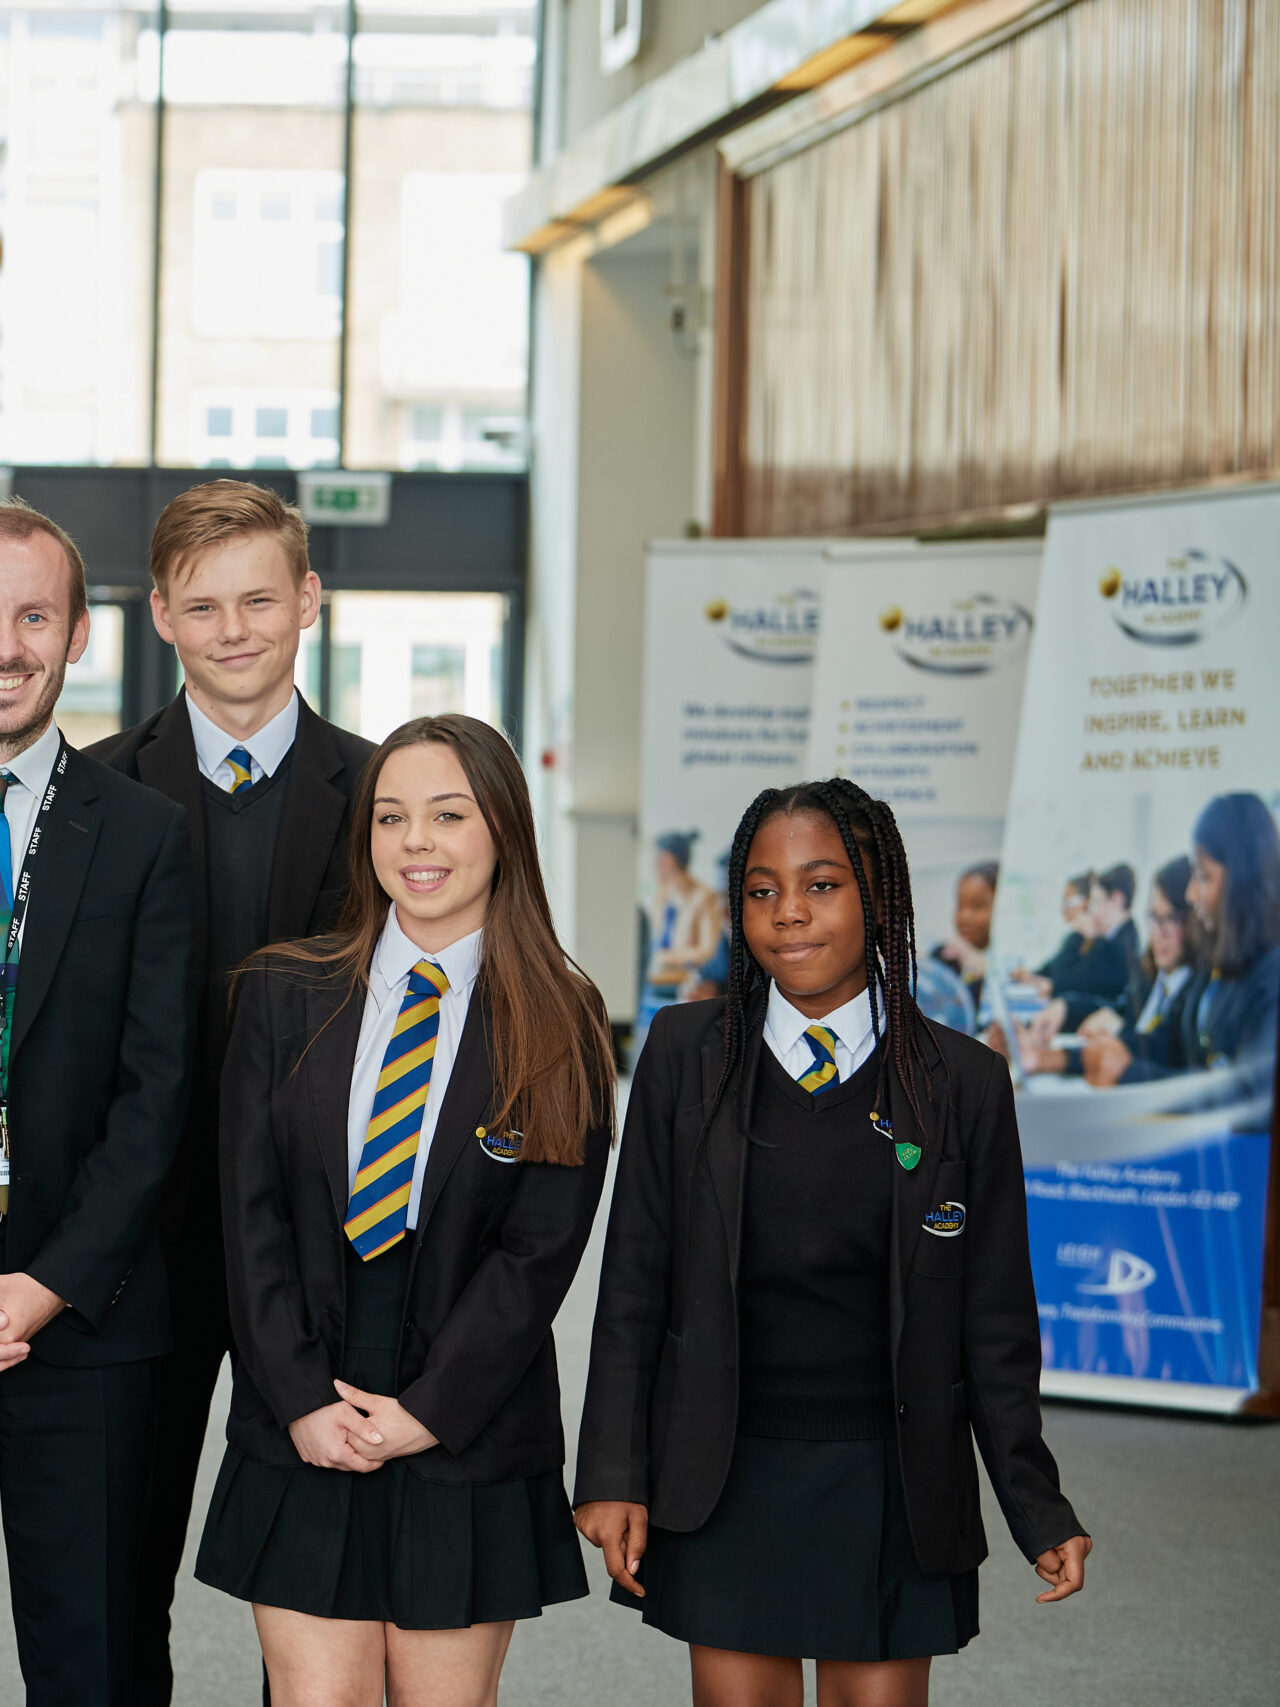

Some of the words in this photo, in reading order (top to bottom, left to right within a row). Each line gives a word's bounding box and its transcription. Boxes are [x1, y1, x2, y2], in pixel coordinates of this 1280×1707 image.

[1123, 573, 1231, 606] HALLEY
[732, 609, 818, 633] HALLE
[906, 614, 1018, 642] HALLEY
[1089, 671, 1195, 698] TOGETHER
[1201, 668, 1236, 691] WE
[1084, 710, 1169, 736] INSPIRE,
[1178, 706, 1246, 732] LEARN
[57, 751, 69, 775] STAFF
[1081, 751, 1125, 772] AND
[1131, 746, 1222, 771] ACHIEVE
[42, 785, 58, 811] STAFF
[29, 827, 42, 855] STAFF
[18, 871, 31, 901] STAFF
[8, 918, 20, 948] STAFF
[925, 1211, 963, 1222] HALLEY
